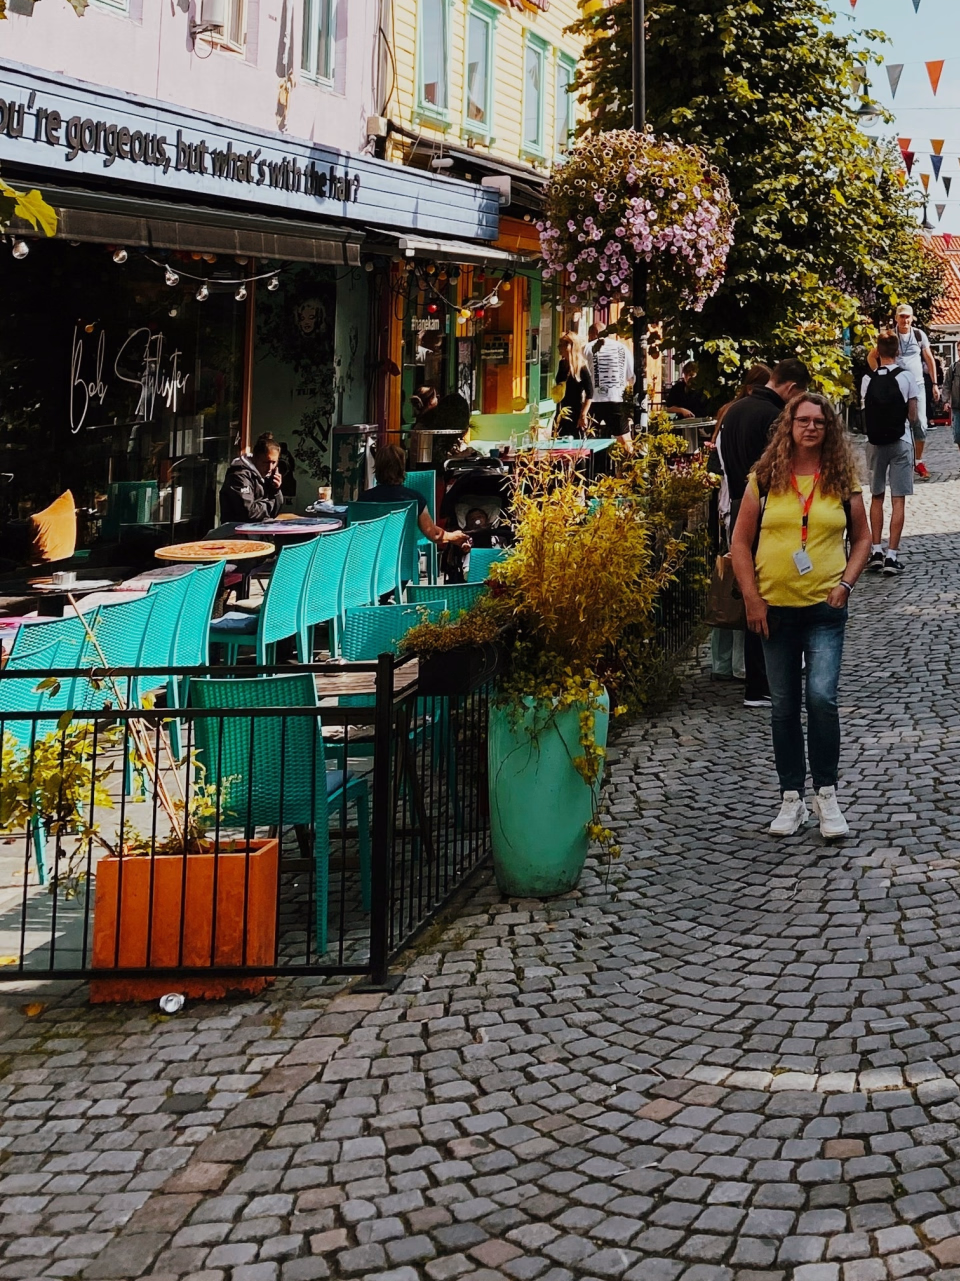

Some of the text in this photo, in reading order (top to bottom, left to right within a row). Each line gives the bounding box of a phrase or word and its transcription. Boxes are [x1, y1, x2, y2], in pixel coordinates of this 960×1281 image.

[65, 116, 171, 175] gorgeous,
[175, 128, 208, 176] but
[269, 156, 301, 193] with
[304, 161, 328, 198] the
[328, 165, 360, 204] hair?
[71, 326, 108, 434] Bob
